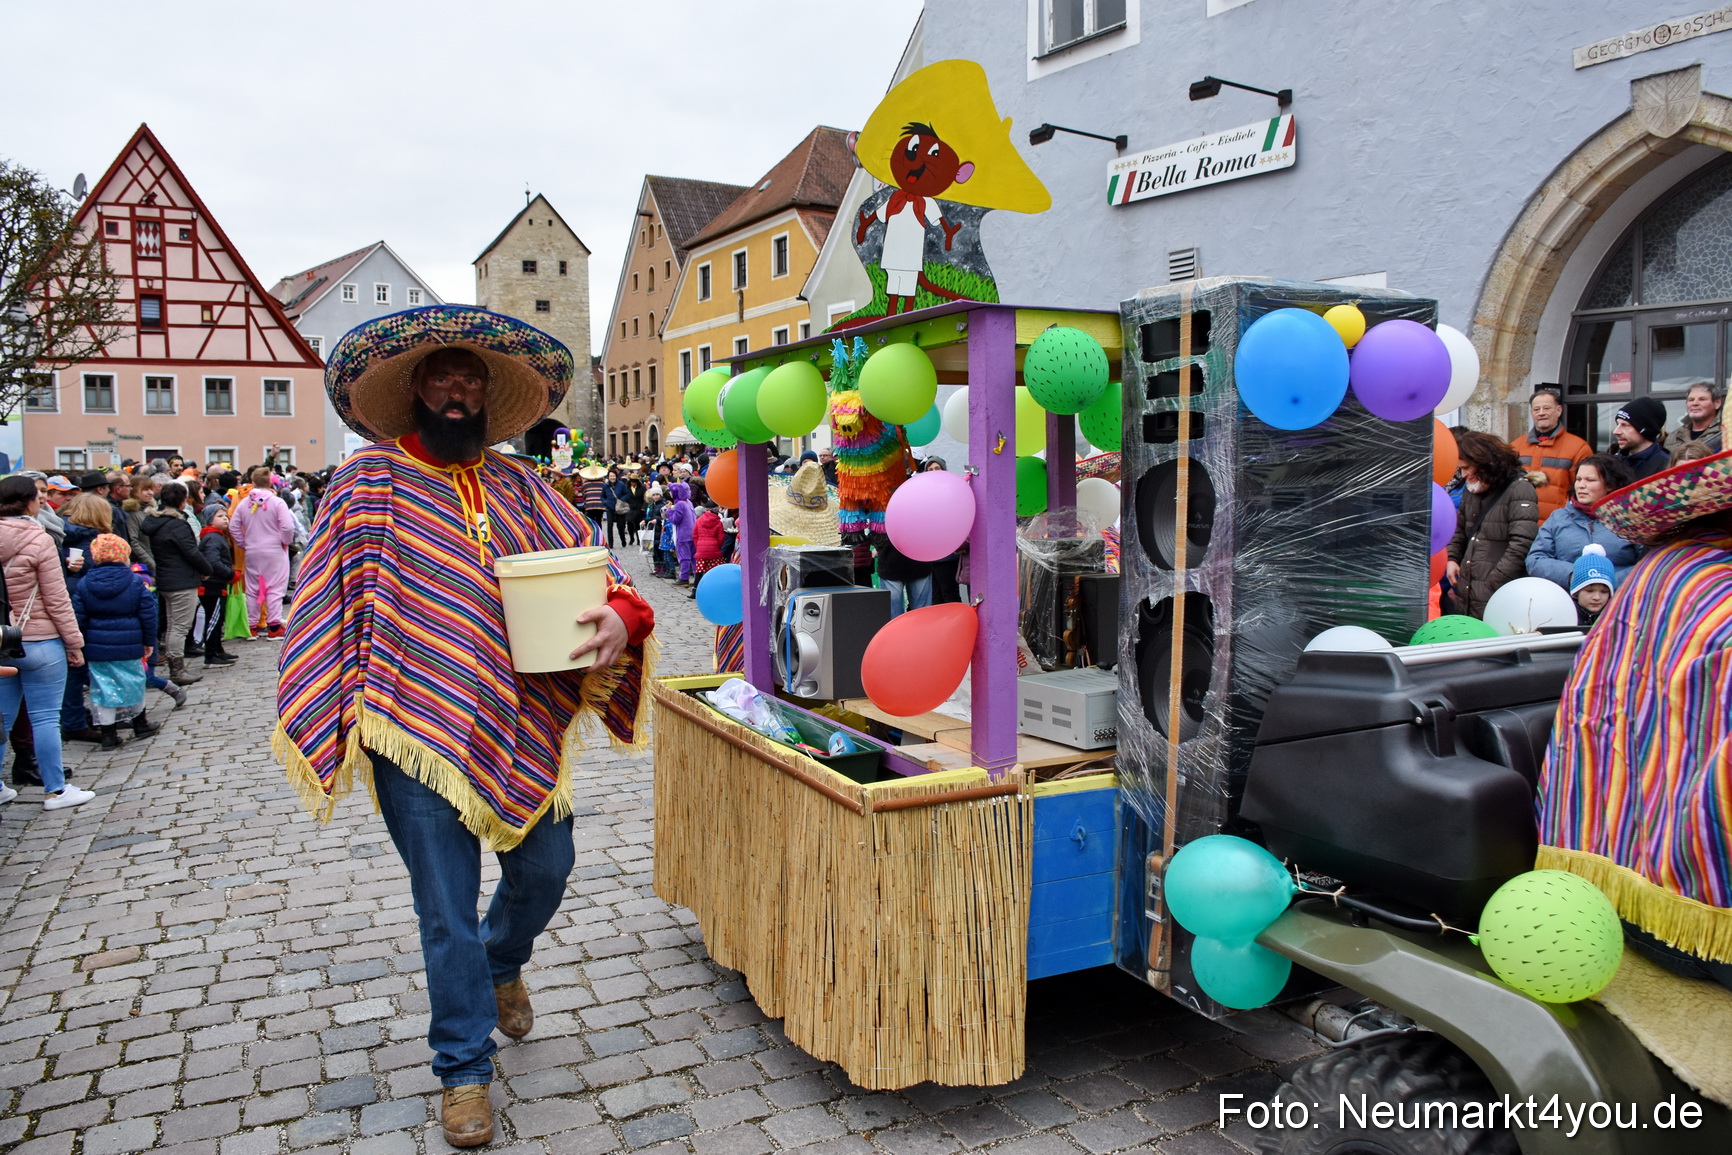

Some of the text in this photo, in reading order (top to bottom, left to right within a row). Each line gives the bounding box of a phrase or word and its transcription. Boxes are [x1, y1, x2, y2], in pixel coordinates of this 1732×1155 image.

[1142, 149, 1177, 165] Pizzeria
[1186, 140, 1208, 154] Café
[1217, 129, 1256, 146] Eisdiele
[1135, 152, 1257, 194] Bella Roma
